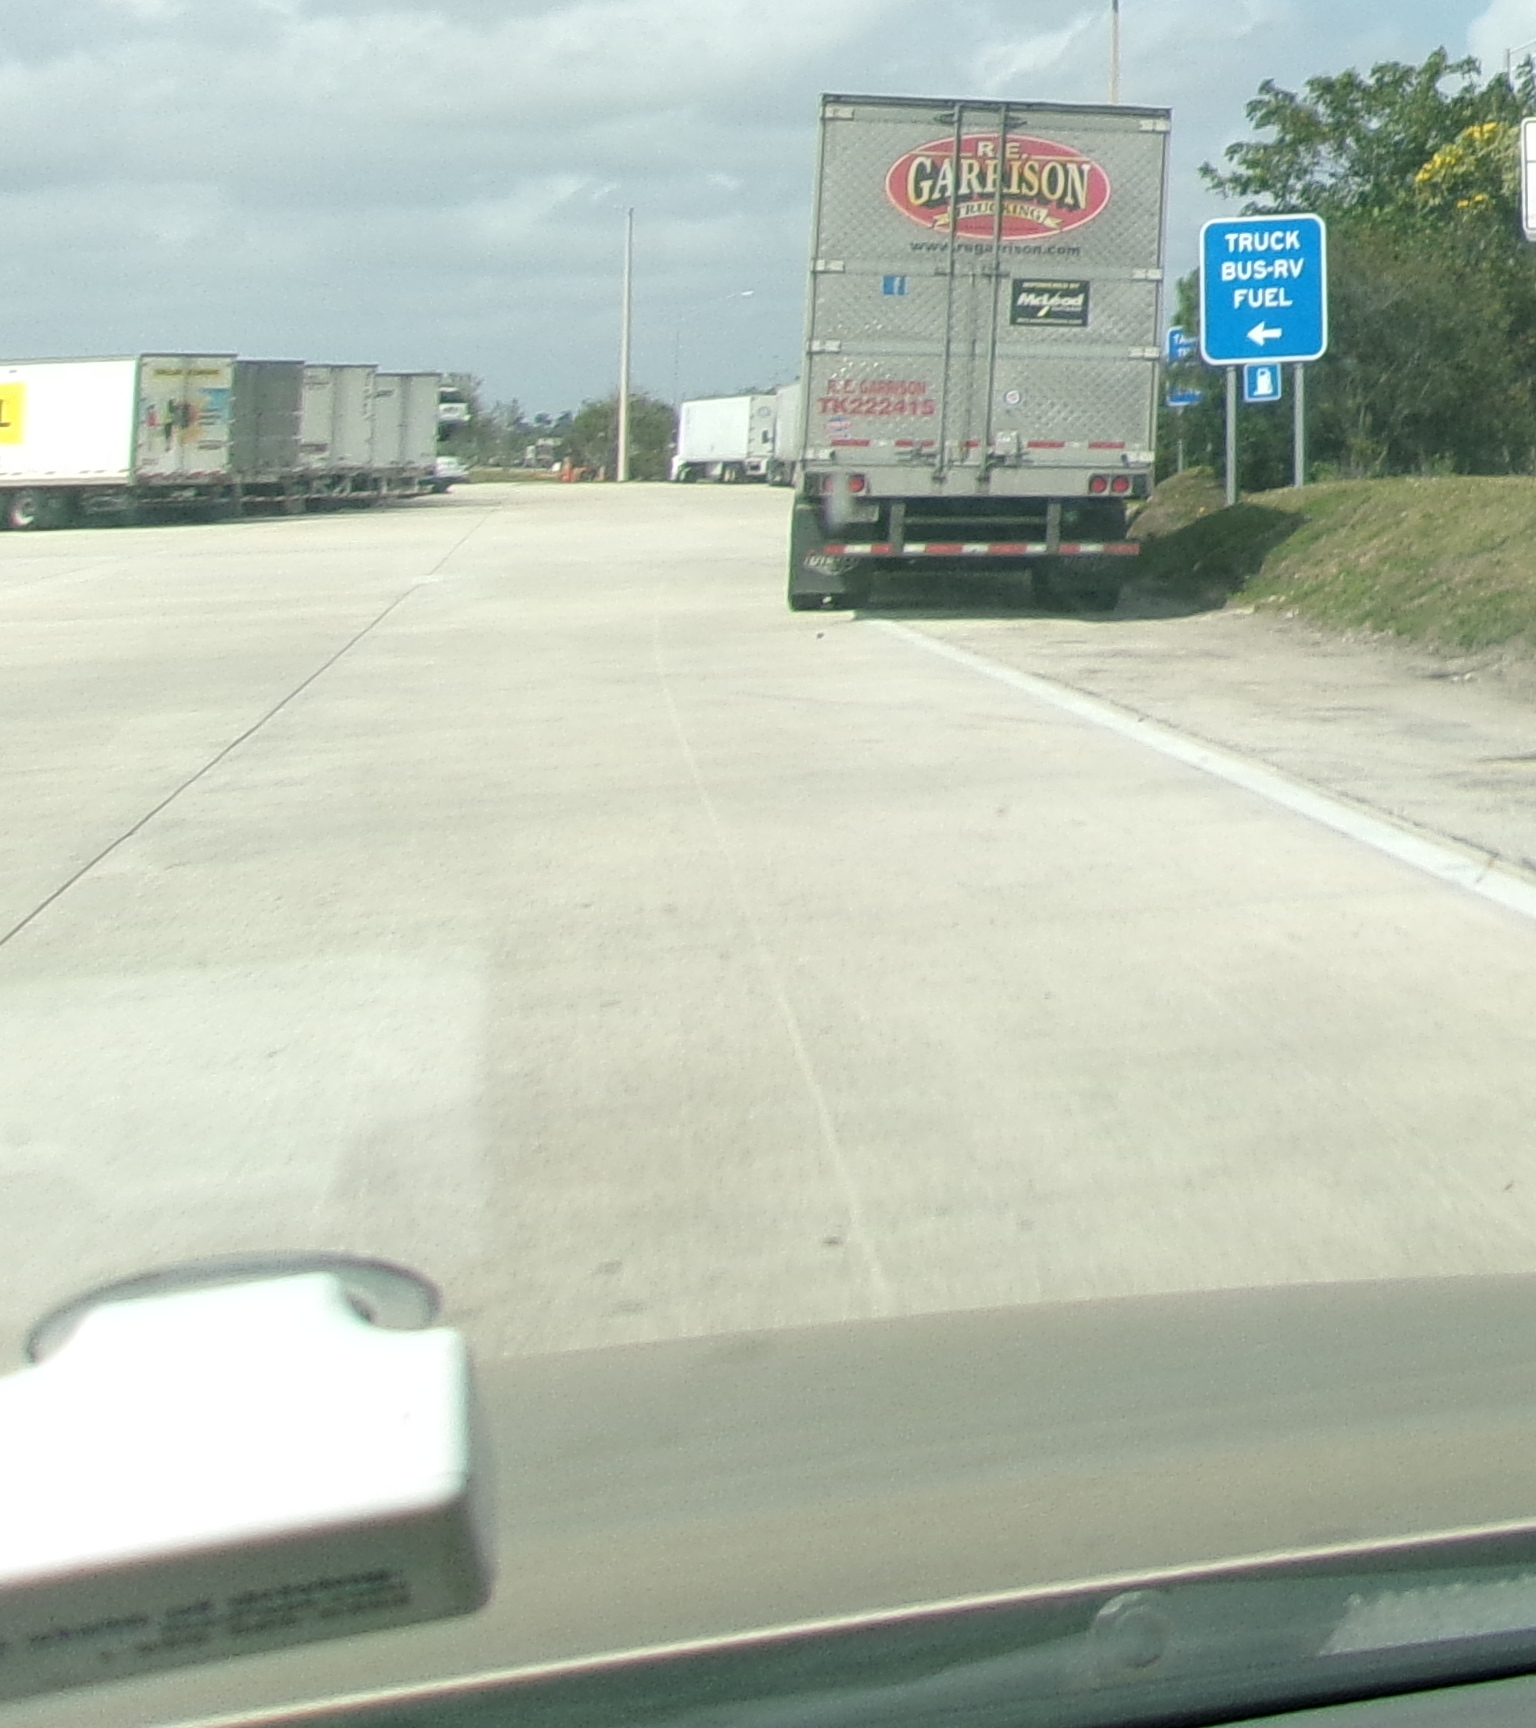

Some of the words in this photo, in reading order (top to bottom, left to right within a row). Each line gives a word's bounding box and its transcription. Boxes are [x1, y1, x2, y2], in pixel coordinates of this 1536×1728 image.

[1224, 230, 1300, 253] TRUCK
[1221, 257, 1304, 282] BUS-RV
[1233, 287, 1293, 309] FUEL
